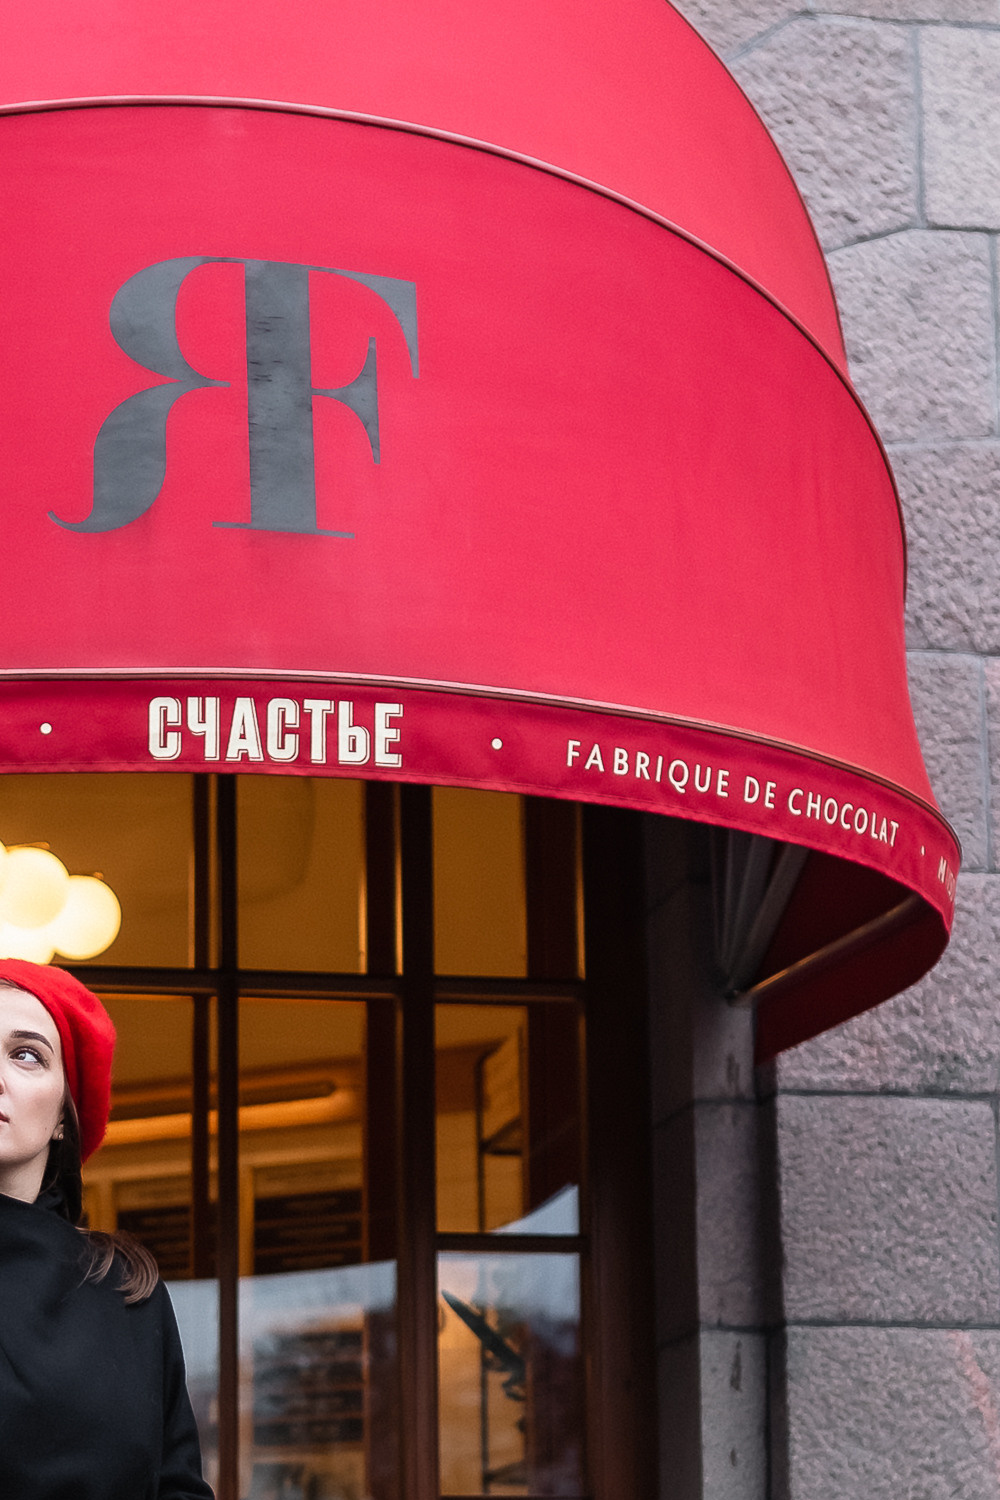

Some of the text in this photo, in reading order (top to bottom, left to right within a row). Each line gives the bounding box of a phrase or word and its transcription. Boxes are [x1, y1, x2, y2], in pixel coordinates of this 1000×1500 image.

[148, 696, 405, 768] СЧАСТЬЕ
[566, 739, 900, 847] FABRIQUE DE CHOCOLAT
